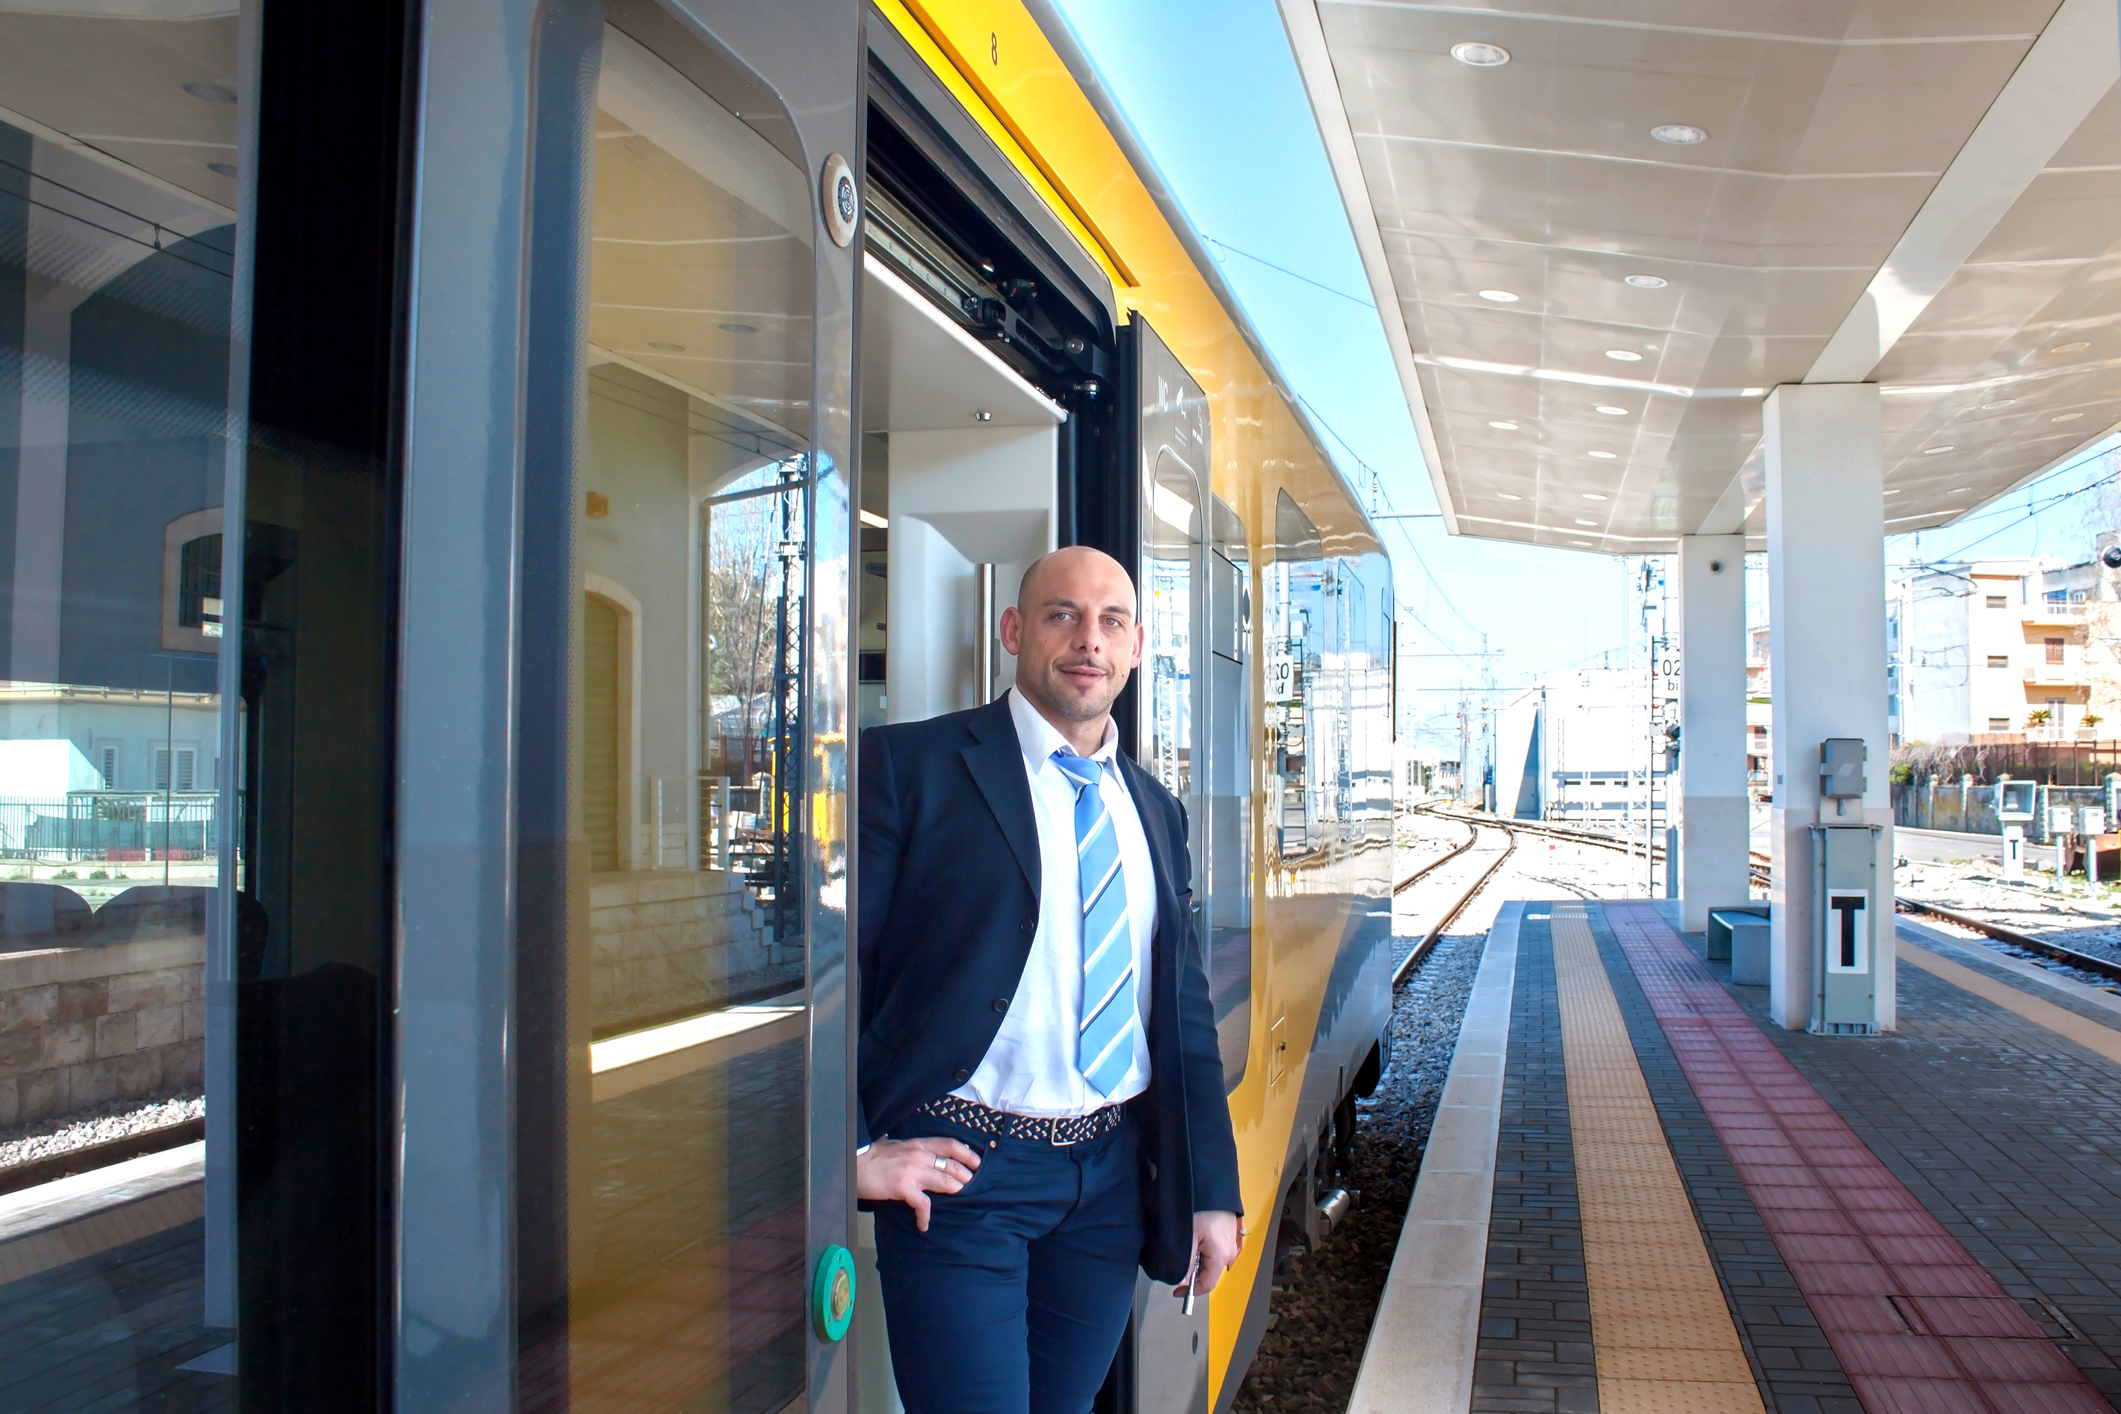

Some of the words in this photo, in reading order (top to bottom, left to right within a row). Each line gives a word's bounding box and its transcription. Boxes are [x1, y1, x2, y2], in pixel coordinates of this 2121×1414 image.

[991, 31, 998, 66] 8
[2009, 839, 2019, 860] T
[1831, 896, 1865, 967] T
